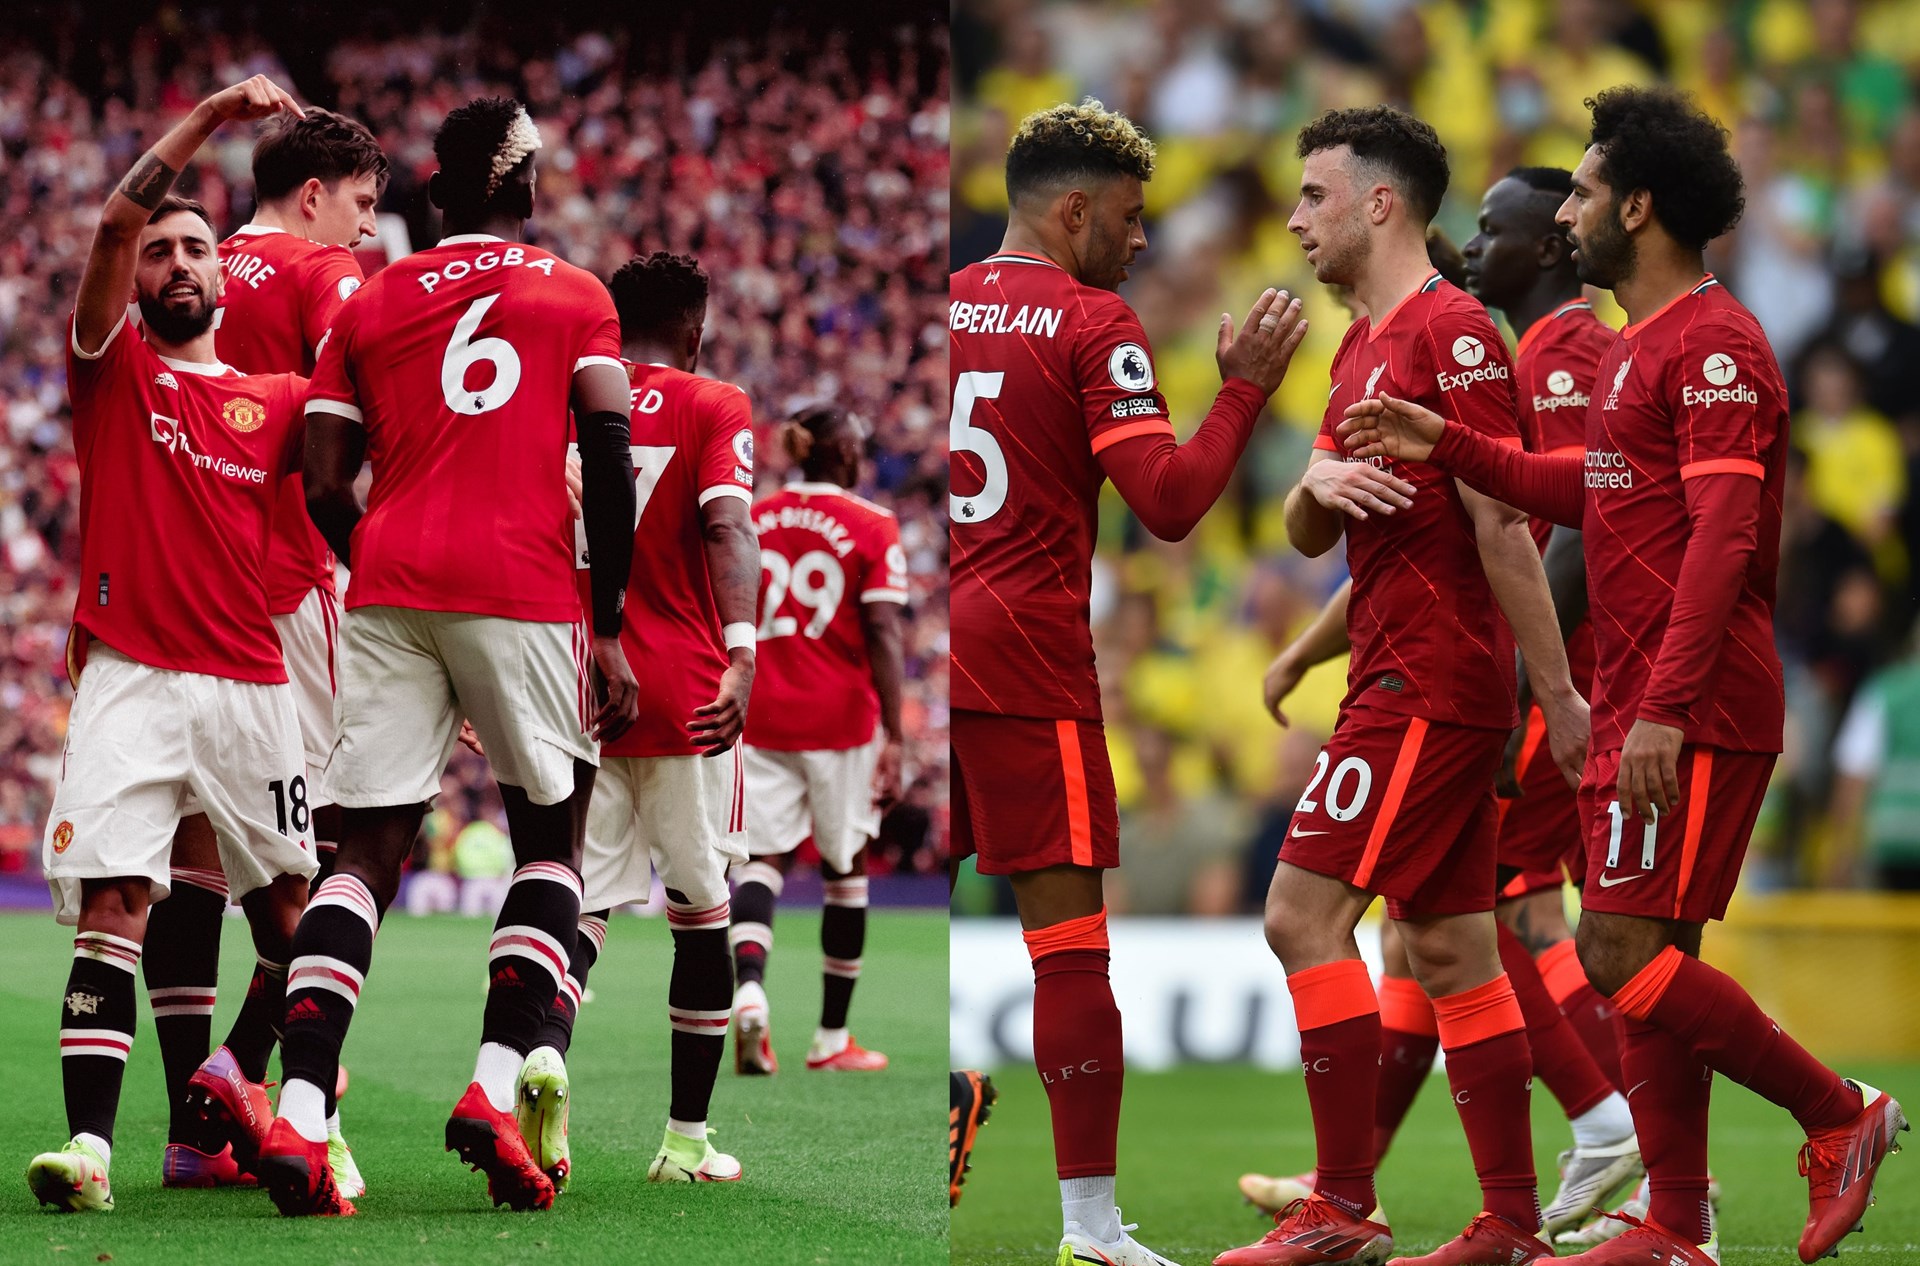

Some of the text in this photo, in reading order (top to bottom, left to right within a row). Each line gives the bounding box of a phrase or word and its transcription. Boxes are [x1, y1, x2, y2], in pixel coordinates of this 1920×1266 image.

[218, 253, 276, 289] UIRE
[418, 247, 556, 294] POGBA
[441, 293, 521, 415] 6
[1437, 361, 1508, 392] Expedia
[1533, 391, 1591, 413] Expedia
[1603, 398, 1619, 411] LFC
[1682, 383, 1758, 409] Expedia
[949, 371, 1009, 524] 5
[756, 549, 845, 640] 29
[268, 775, 310, 836] 18
[1294, 751, 1373, 822] 20
[1605, 801, 1659, 870] 11
[228, 1069, 257, 1126] ULTRA
